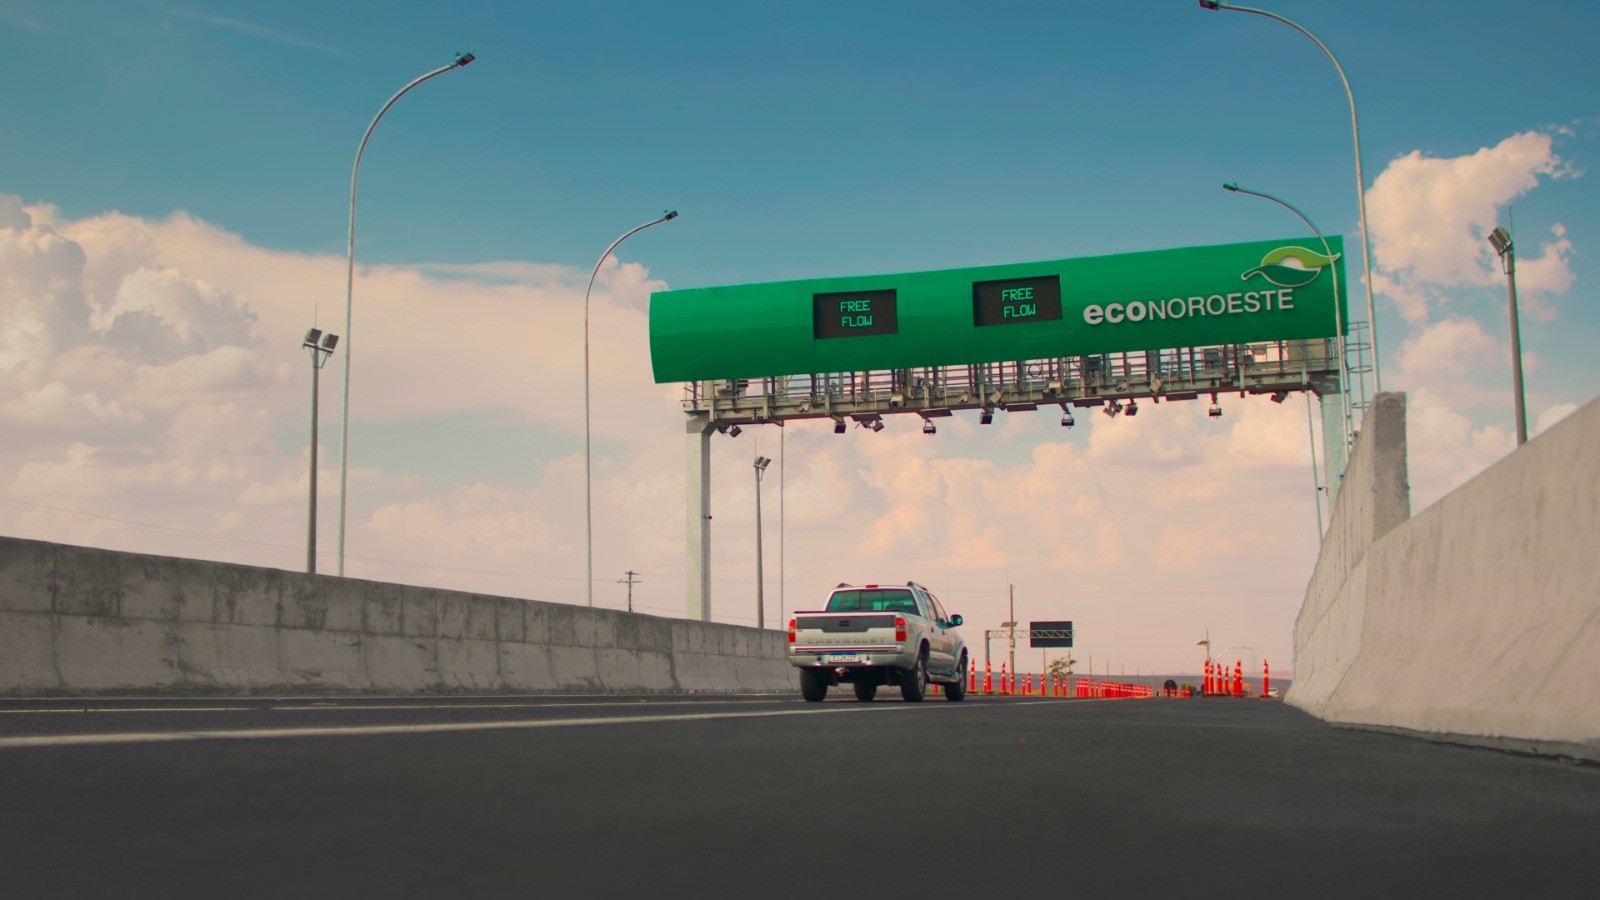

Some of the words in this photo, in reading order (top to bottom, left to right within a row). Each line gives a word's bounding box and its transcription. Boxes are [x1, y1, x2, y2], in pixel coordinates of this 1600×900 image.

[1001, 287, 1034, 302] FREE
[840, 300, 871, 312] FREE
[1003, 303, 1036, 318] FLOW
[1083, 288, 1294, 325] ecoNOROESTE
[841, 315, 873, 327] FLOW
